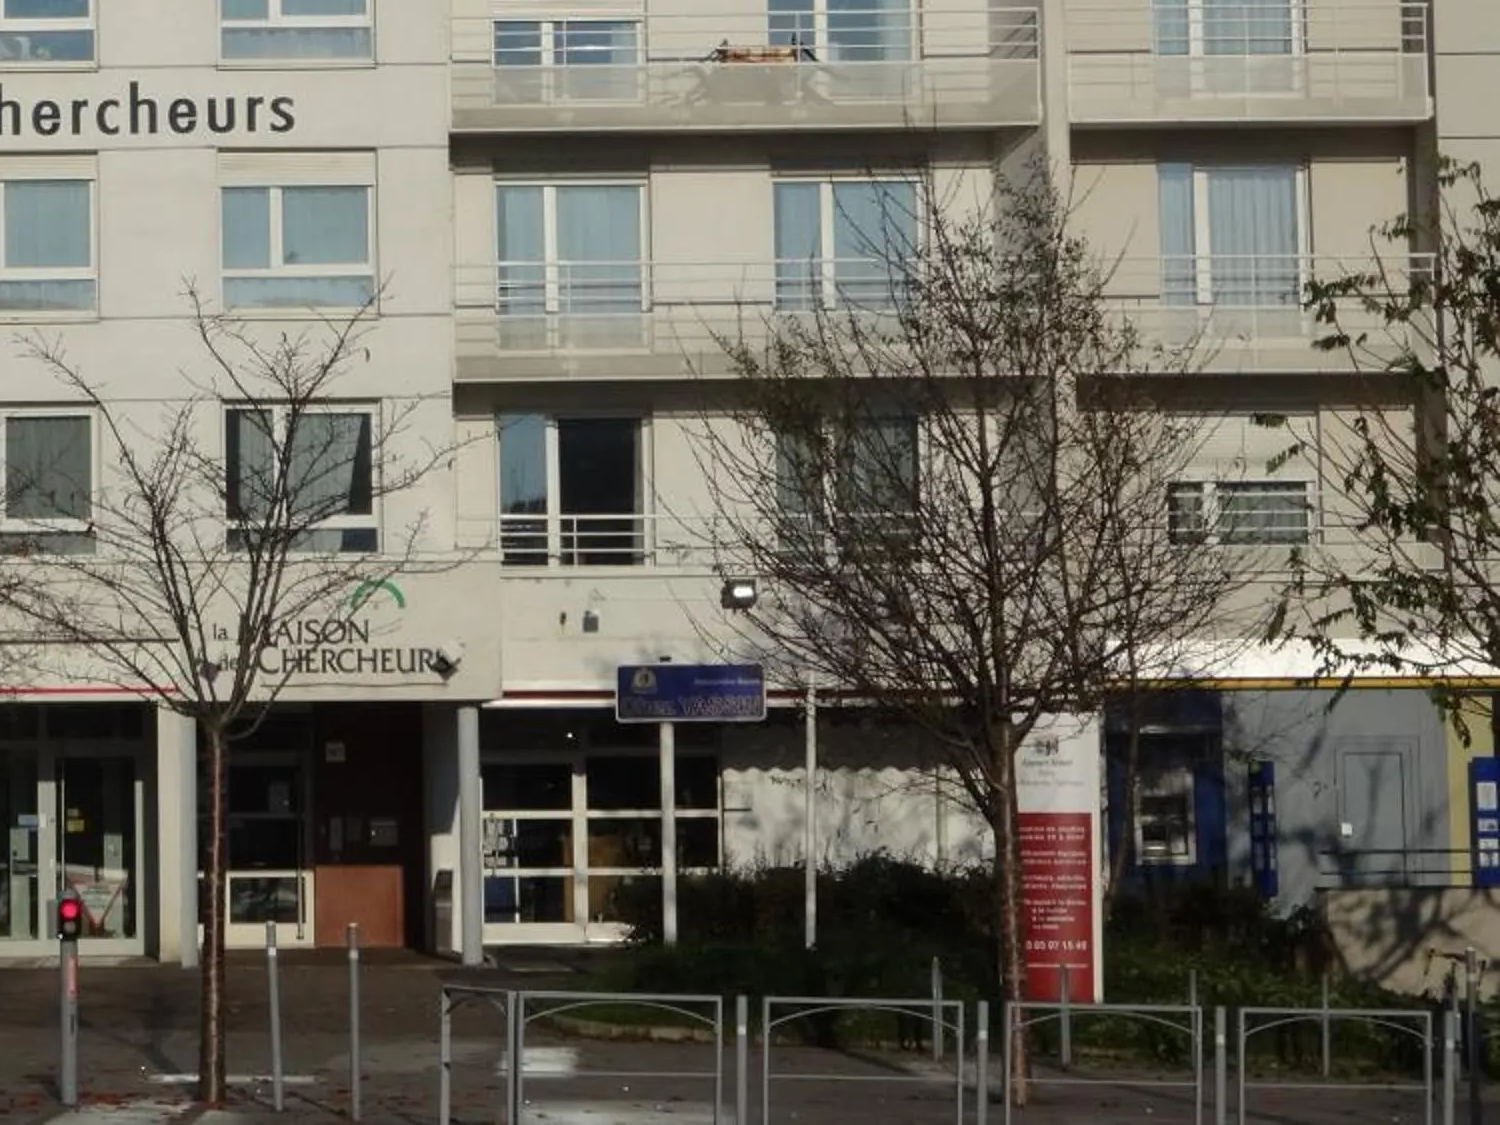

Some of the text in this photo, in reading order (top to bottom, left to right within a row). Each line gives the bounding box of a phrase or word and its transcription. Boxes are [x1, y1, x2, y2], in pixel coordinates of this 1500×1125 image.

[212, 619, 370, 646] la AISON
[258, 646, 446, 674] CHERCHEUR
